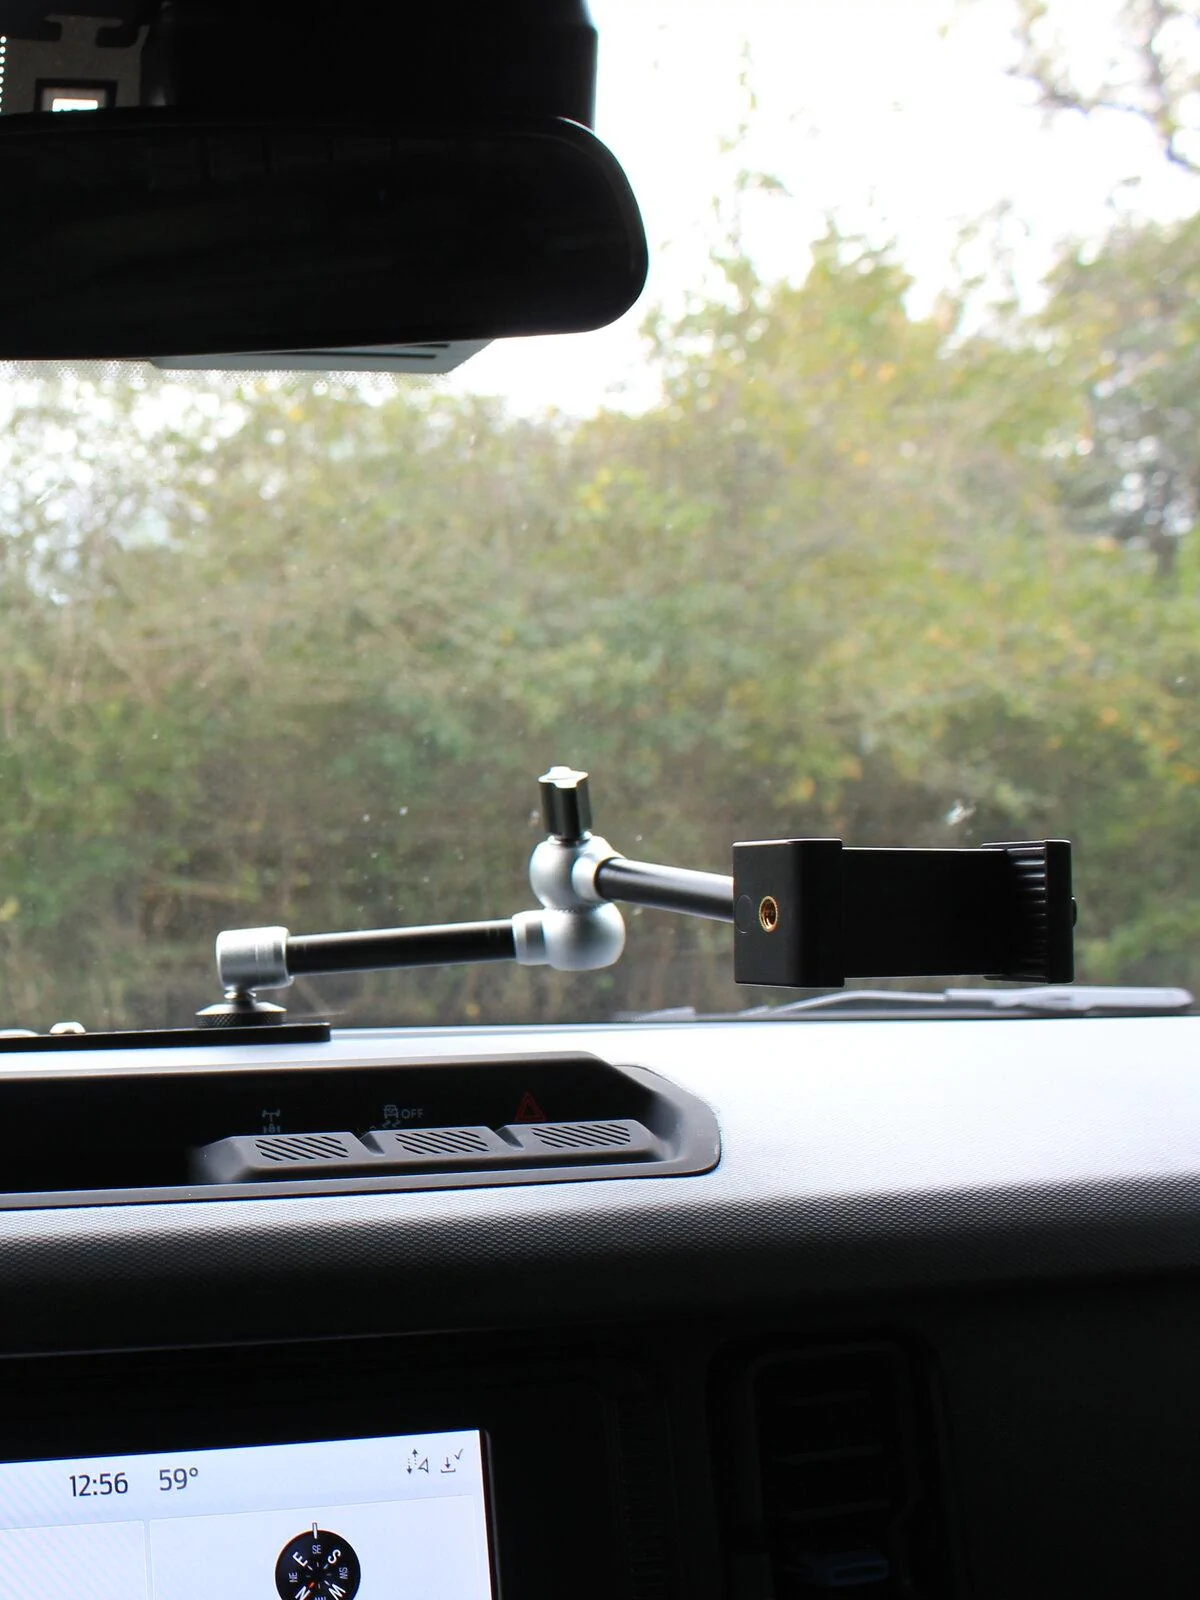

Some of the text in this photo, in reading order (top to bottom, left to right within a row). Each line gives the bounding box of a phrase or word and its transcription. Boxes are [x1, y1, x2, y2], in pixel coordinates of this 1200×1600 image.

[401, 1108, 424, 1119] OFF
[69, 1472, 129, 1497] 12:56
[312, 1545, 322, 1555] SE
[327, 1549, 341, 1564] S
[292, 1551, 308, 1567] E
[294, 1585, 311, 1600] N
